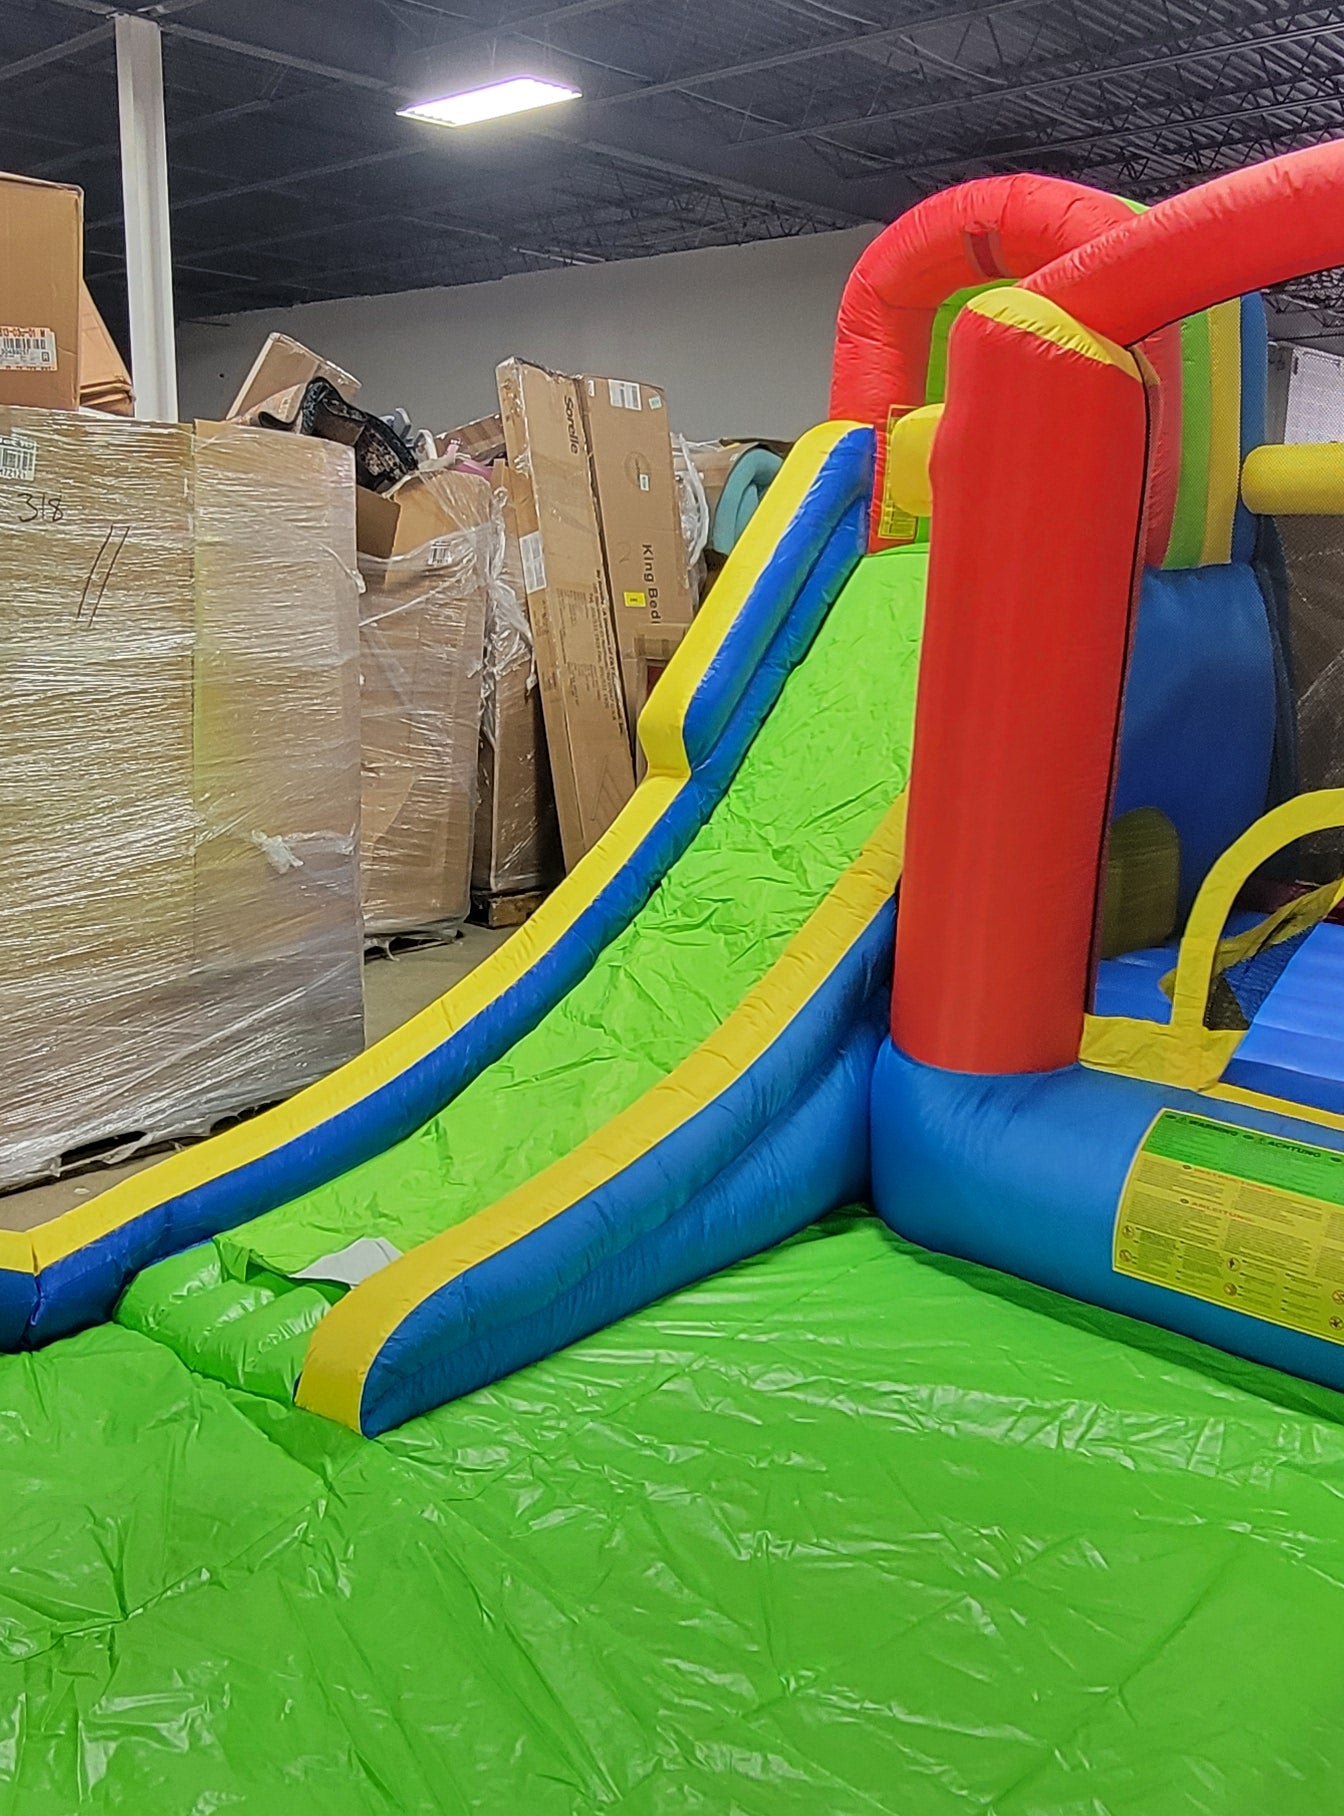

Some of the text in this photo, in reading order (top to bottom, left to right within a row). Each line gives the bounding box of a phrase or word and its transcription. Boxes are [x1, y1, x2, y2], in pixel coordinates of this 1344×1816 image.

[564, 395, 579, 455] Sorelle
[17, 492, 64, 523] 318
[641, 543, 655, 583] King
[1267, 1141, 1322, 1158] ACHTUNG
